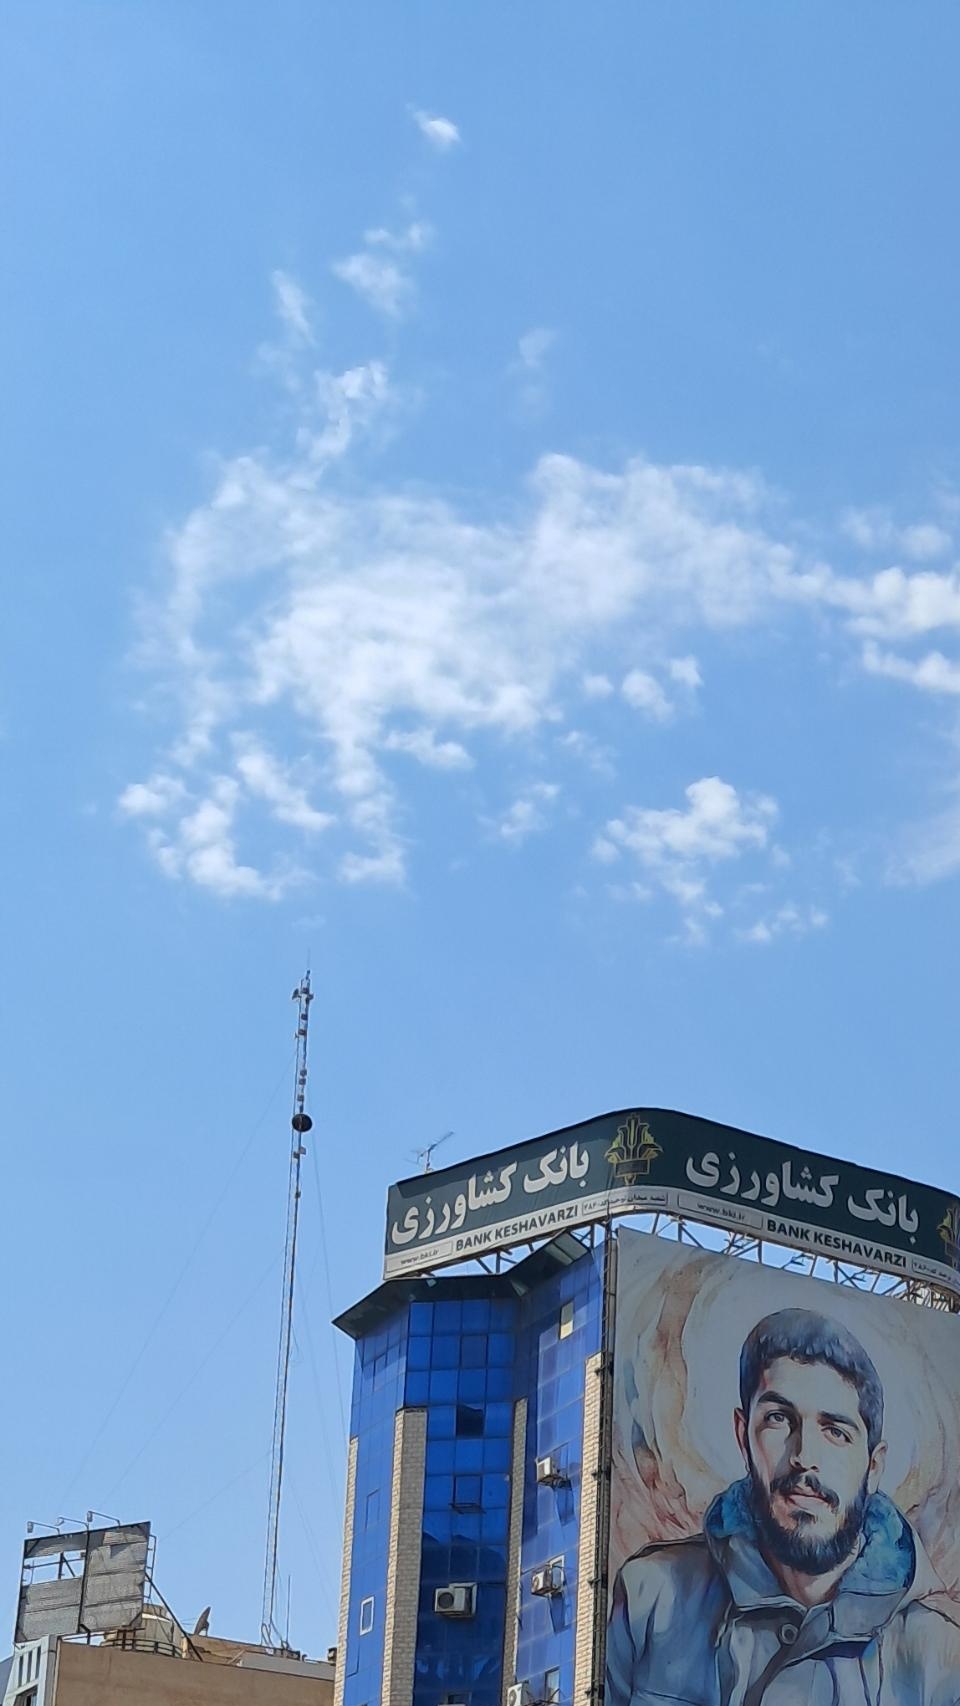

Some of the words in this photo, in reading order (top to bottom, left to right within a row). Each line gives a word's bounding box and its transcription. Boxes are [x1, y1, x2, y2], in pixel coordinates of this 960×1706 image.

[523, 1141, 590, 1193] بانک
[685, 1151, 840, 1208] کشاورزی
[391, 1161, 518, 1245] کشاورزی
[455, 1230, 492, 1252] BANK
[494, 1204, 579, 1240] KESHAVARZI
[847, 1188, 919, 1245] بانک
[767, 1218, 810, 1242] BANK
[813, 1231, 907, 1268] KESHAVARZI
